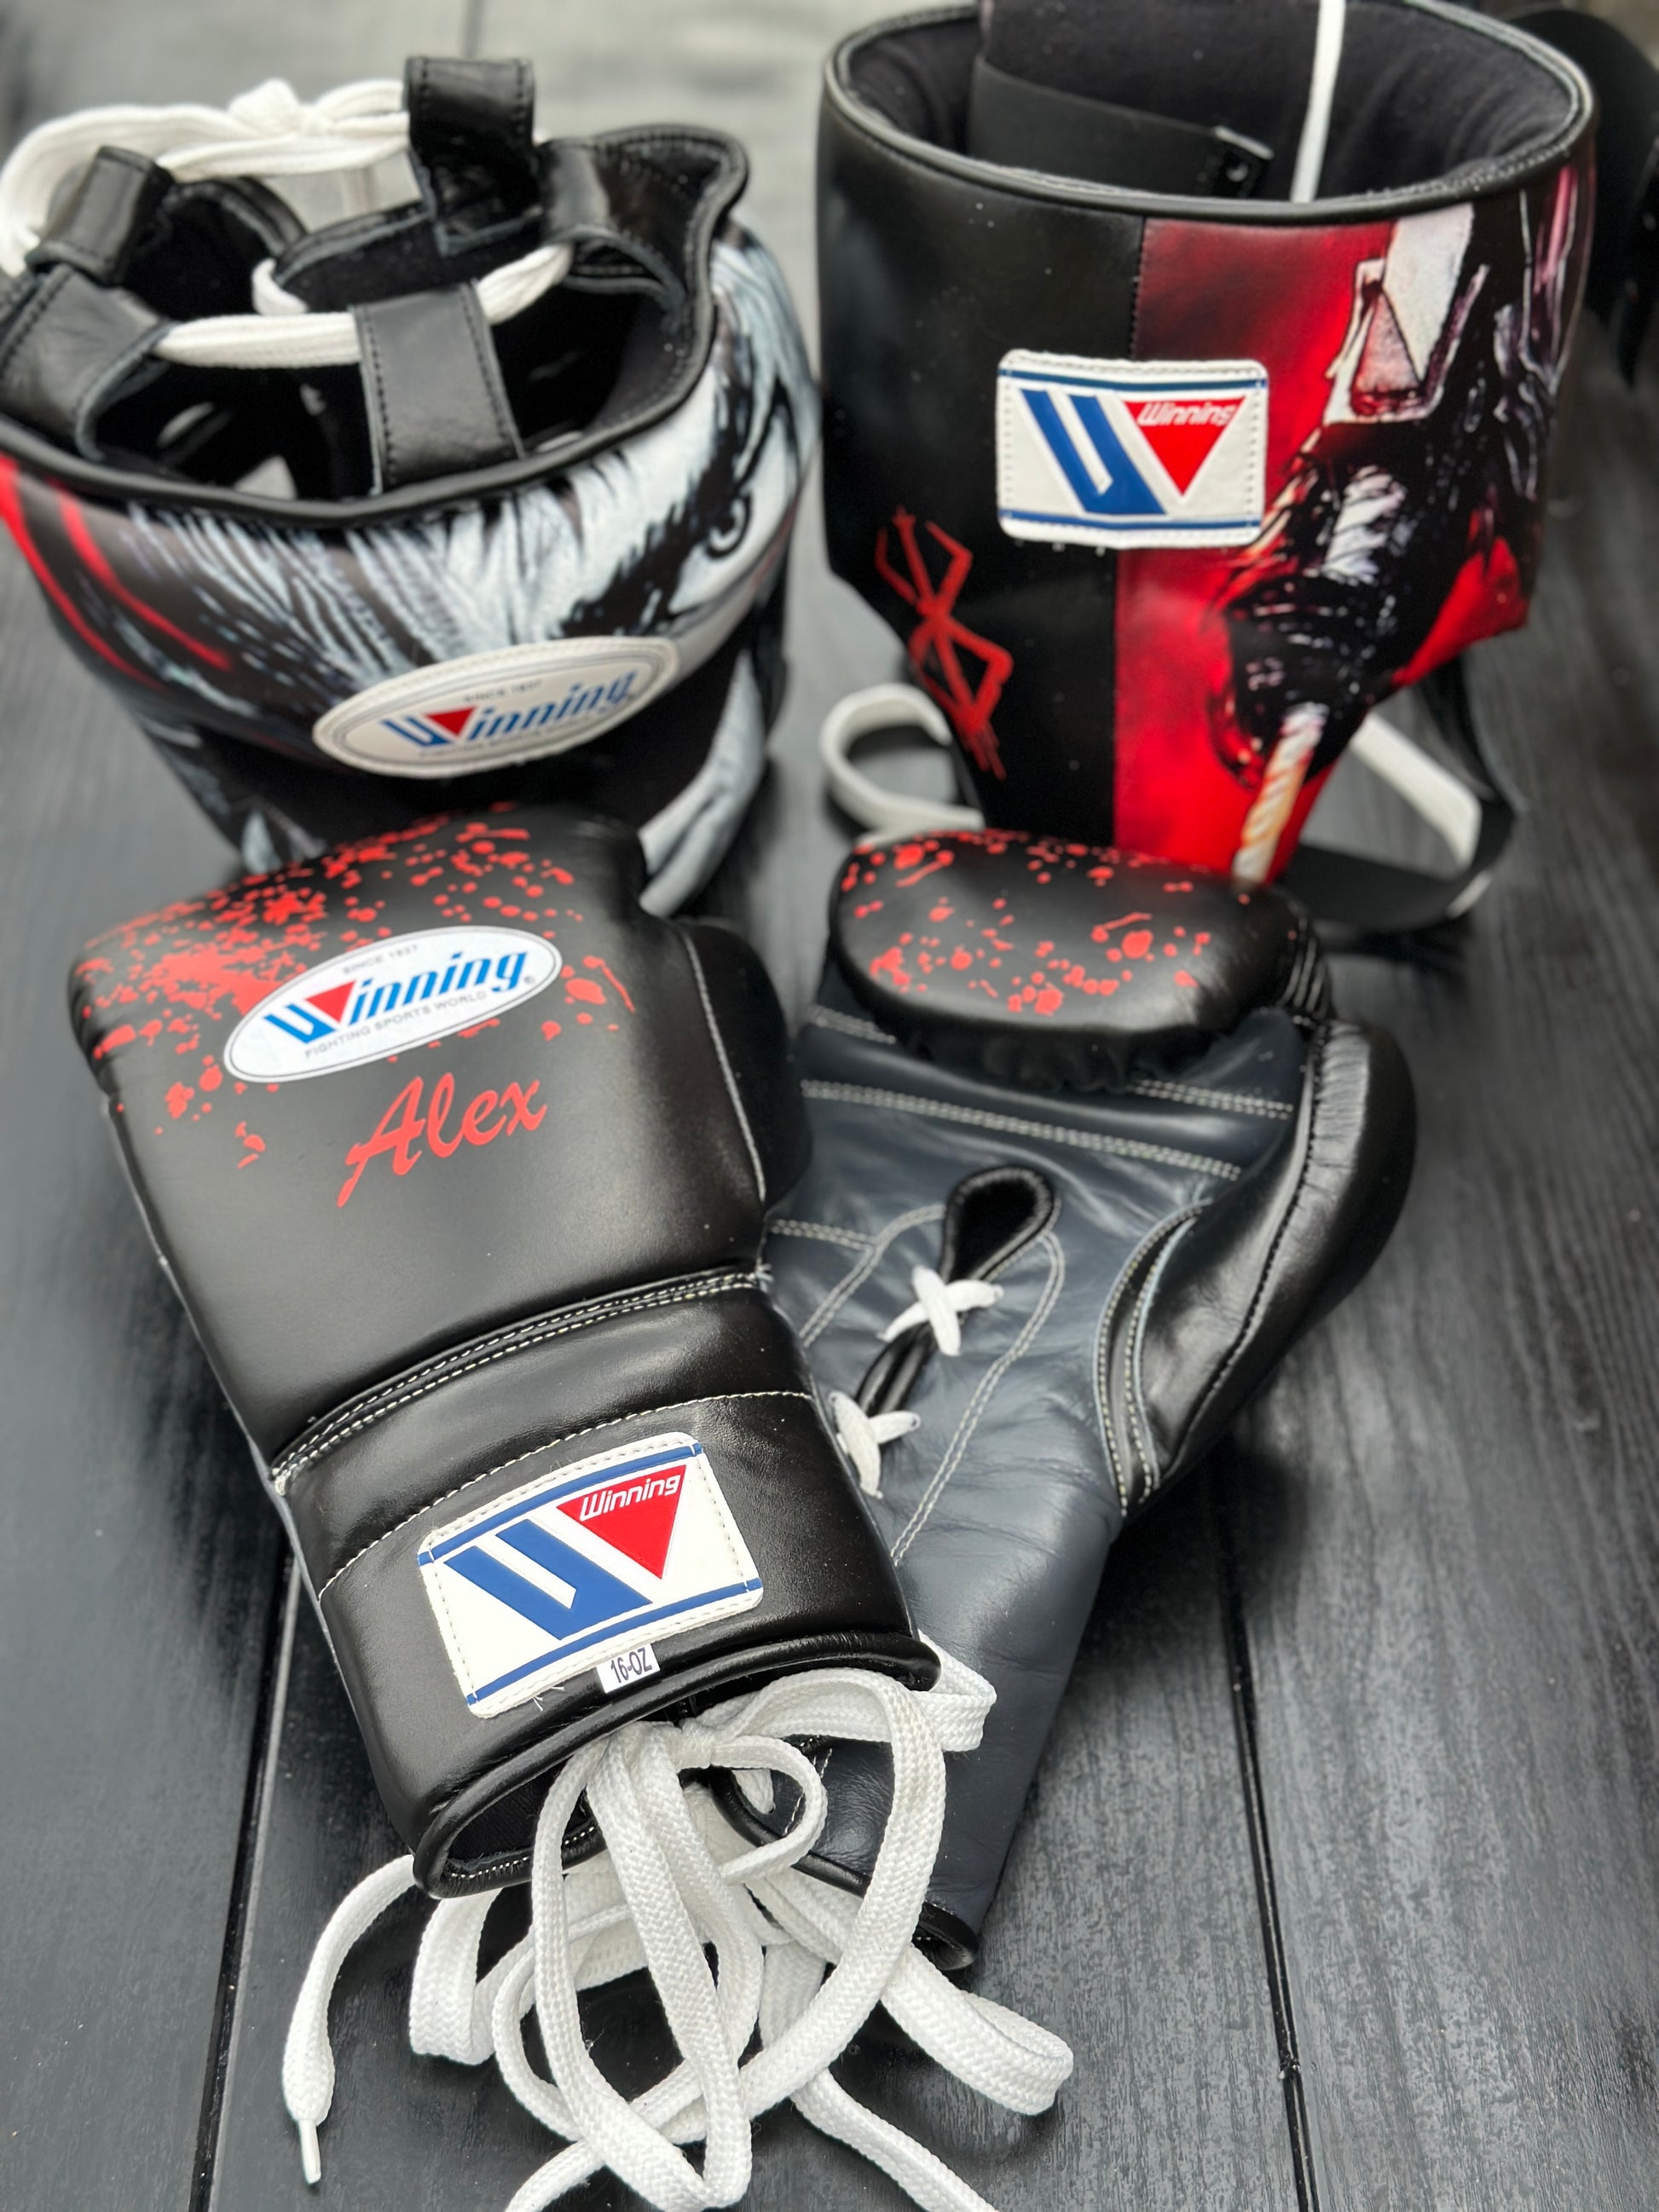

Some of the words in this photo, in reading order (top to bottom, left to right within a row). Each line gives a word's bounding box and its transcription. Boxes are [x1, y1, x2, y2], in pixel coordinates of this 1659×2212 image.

[1136, 400, 1238, 427] Winning
[379, 669, 638, 748] Winning
[343, 954, 384, 974] SINCE
[263, 951, 528, 1044] Winning
[304, 1026, 371, 1060] FIGHTING
[375, 1005, 432, 1031] SPORTS
[433, 990, 488, 1012] WORLD
[336, 1071, 548, 1208] Alex
[578, 1474, 682, 1522] Winning
[610, 1647, 653, 1684] 16-OZ
